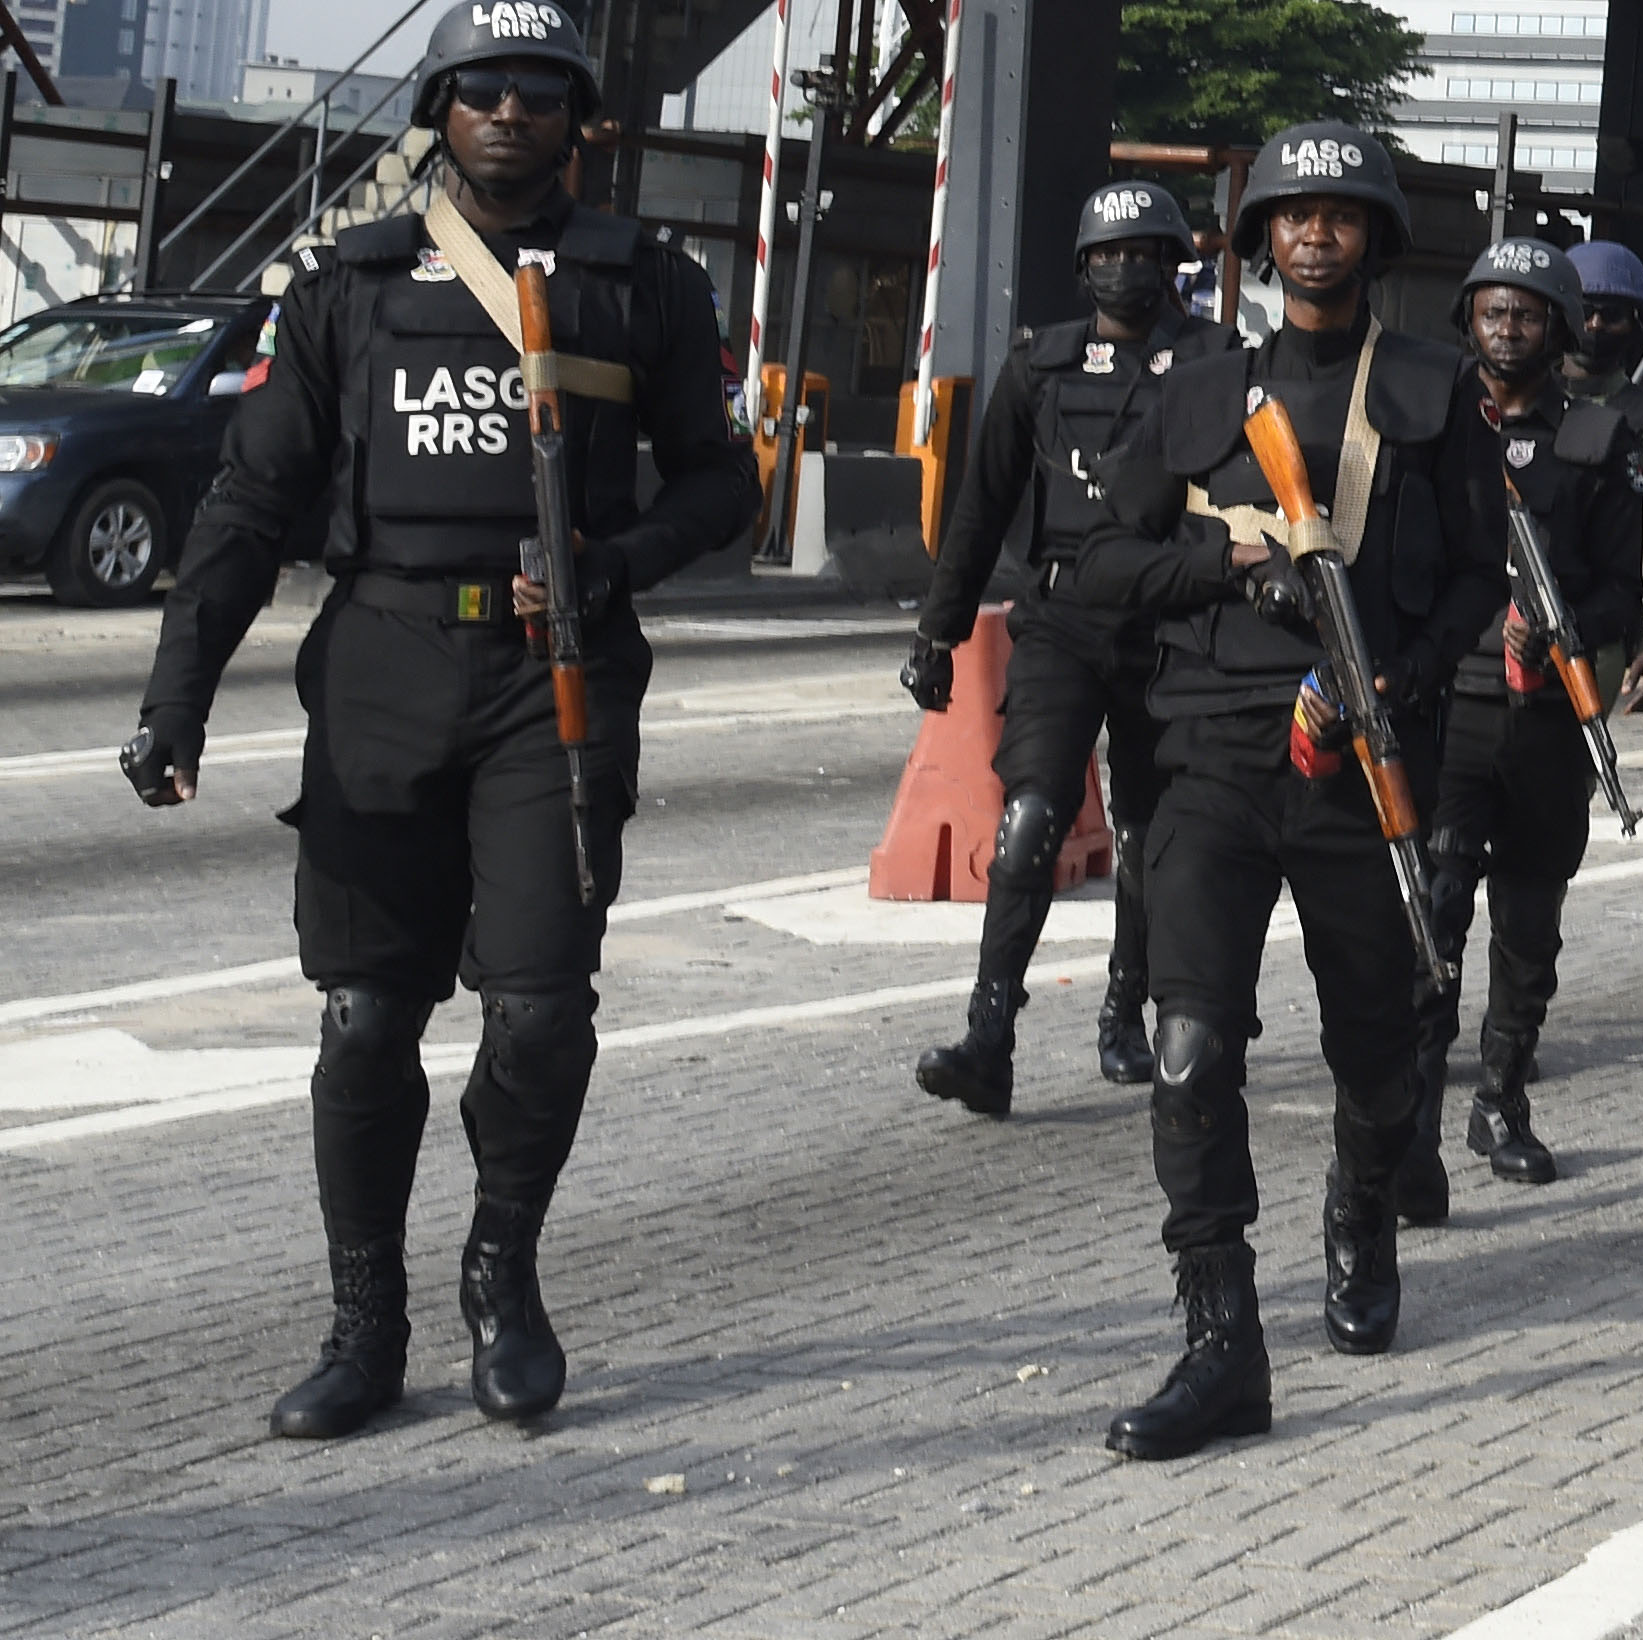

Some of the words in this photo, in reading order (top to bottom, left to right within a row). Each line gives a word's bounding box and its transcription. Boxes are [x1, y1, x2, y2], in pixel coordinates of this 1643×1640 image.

[1281, 139, 1363, 168] LASG
[1297, 159, 1343, 178] RRS
[393, 365, 530, 412] LASG
[407, 413, 510, 456] RRS
